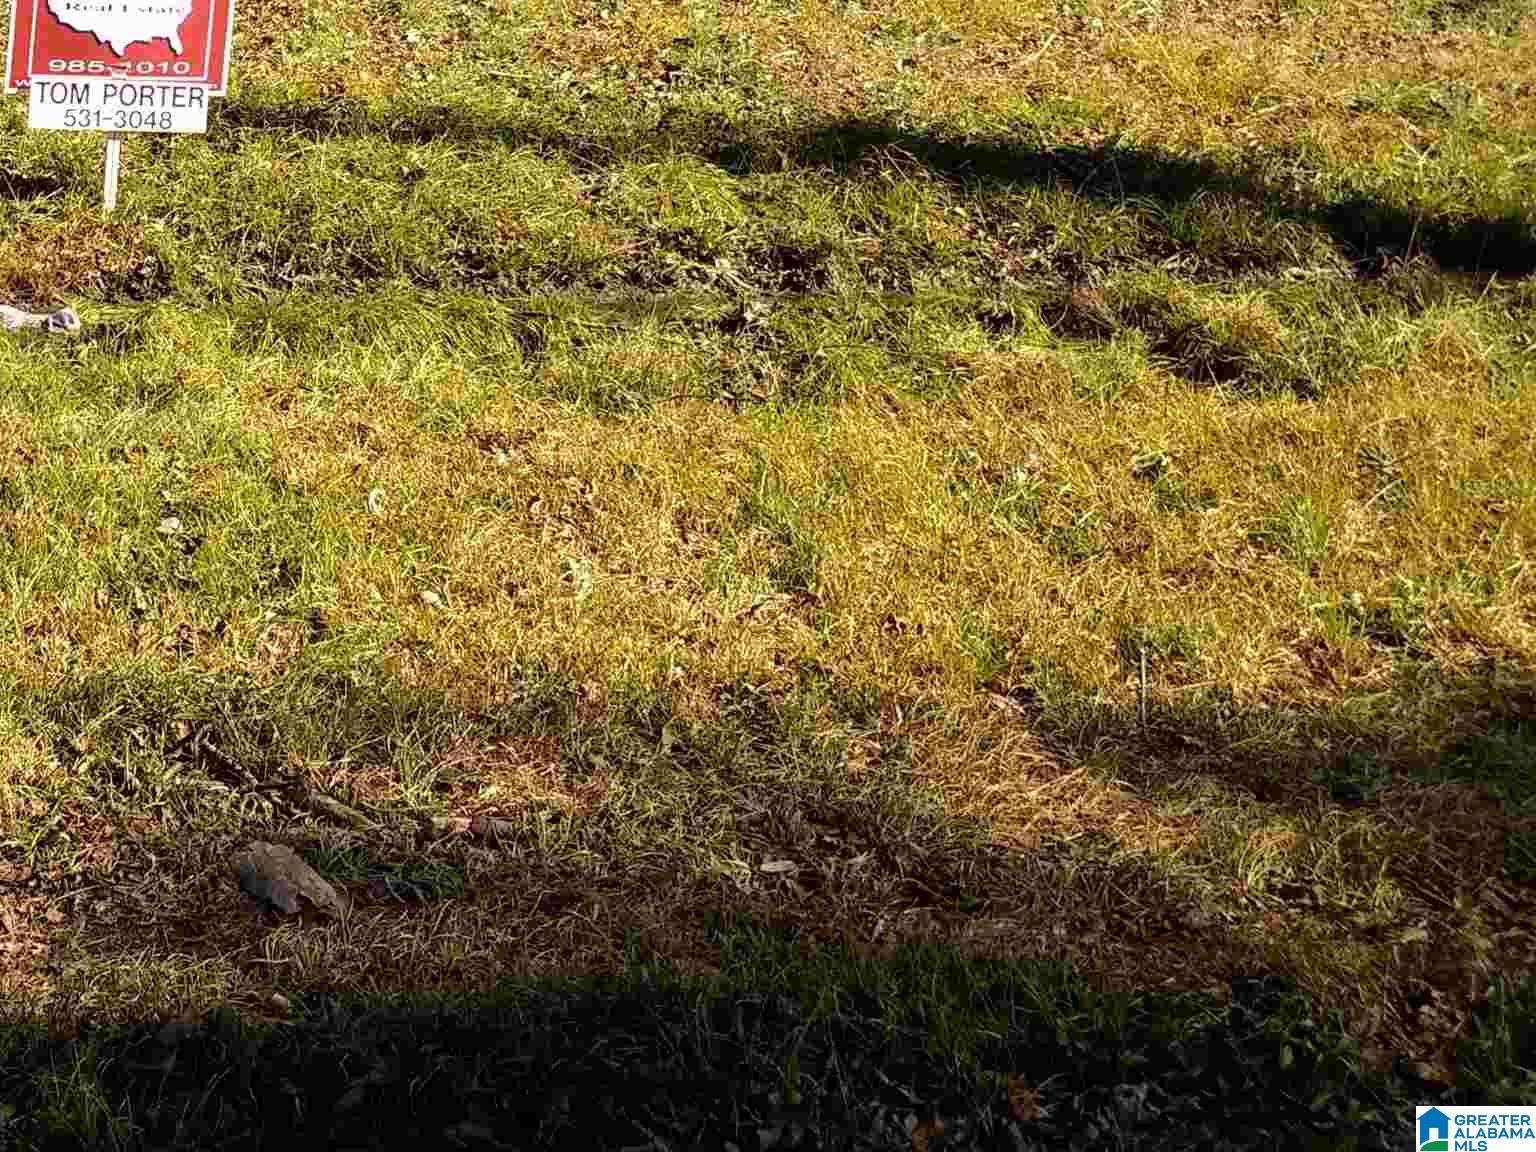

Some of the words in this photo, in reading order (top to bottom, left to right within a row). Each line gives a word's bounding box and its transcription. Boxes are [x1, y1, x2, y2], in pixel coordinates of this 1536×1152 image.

[35, 82, 90, 105] TOM
[103, 84, 205, 108] PORTER
[63, 109, 173, 129] 531-3048
